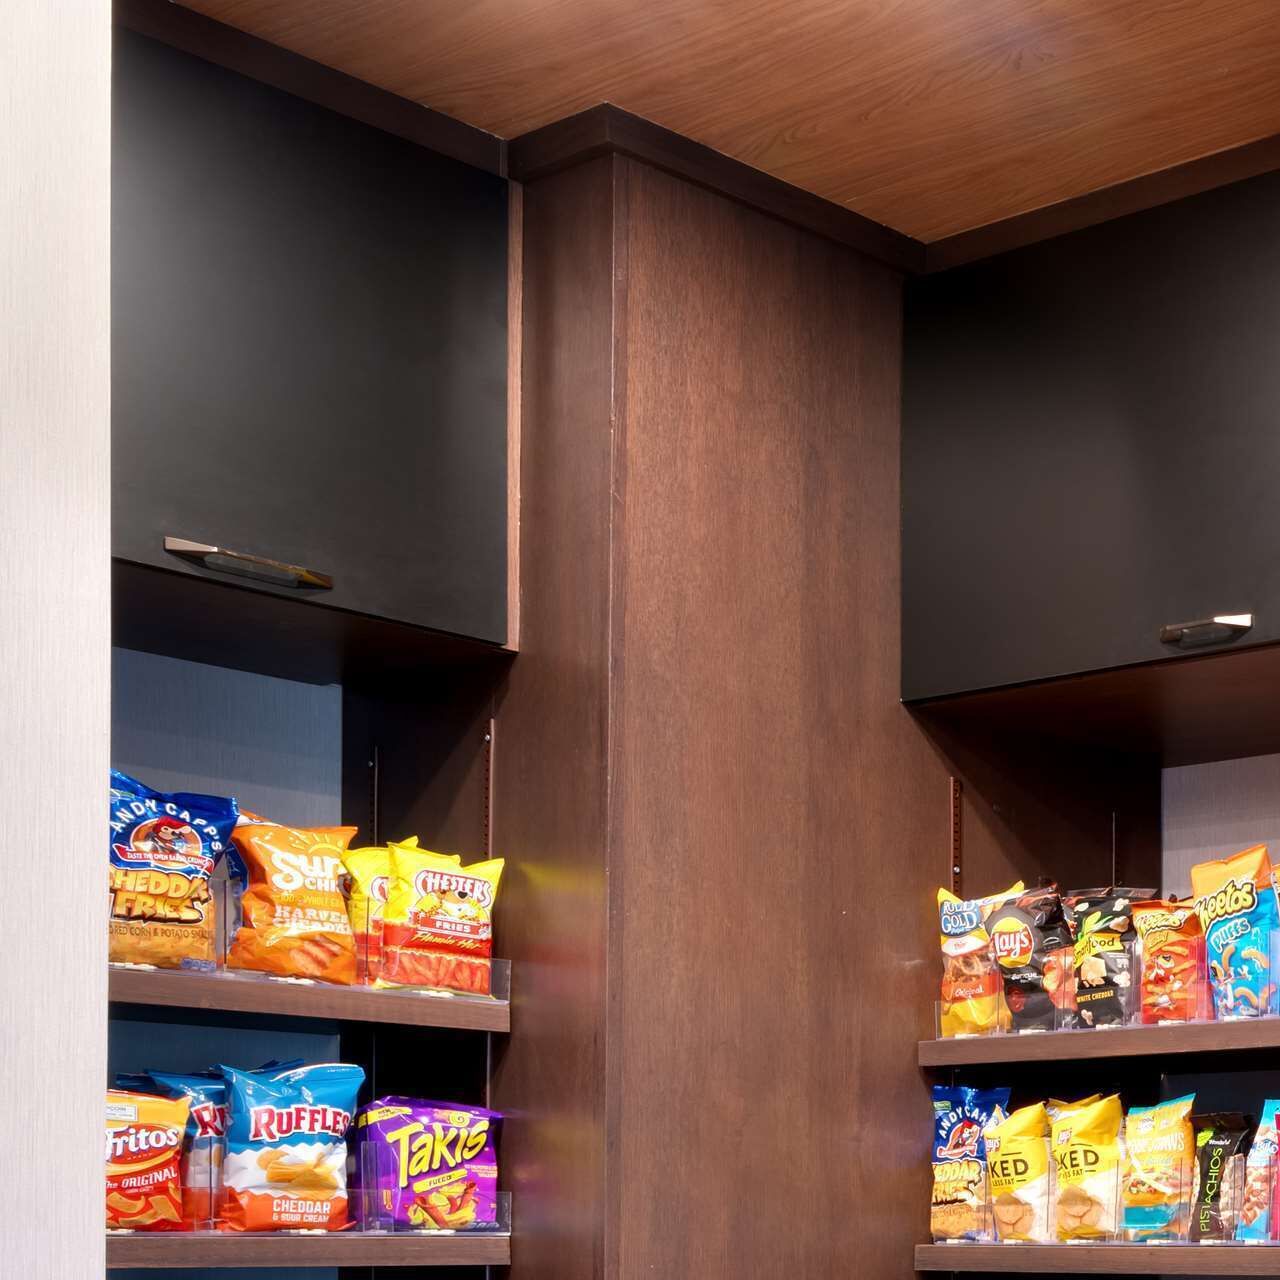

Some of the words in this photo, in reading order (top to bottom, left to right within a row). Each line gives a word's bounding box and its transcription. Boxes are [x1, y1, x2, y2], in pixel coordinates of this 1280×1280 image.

[110, 799, 157, 833] ANDY
[995, 927, 1032, 958] Lay's
[251, 1106, 350, 1142] RUFFLES
[386, 1120, 490, 1188] Takis
[990, 1159, 1029, 1178] KED
[121, 1166, 178, 1188] ORIGINAL
[1200, 1147, 1223, 1232] PISTACHIOS
[272, 1199, 332, 1215] CHEDDAR
